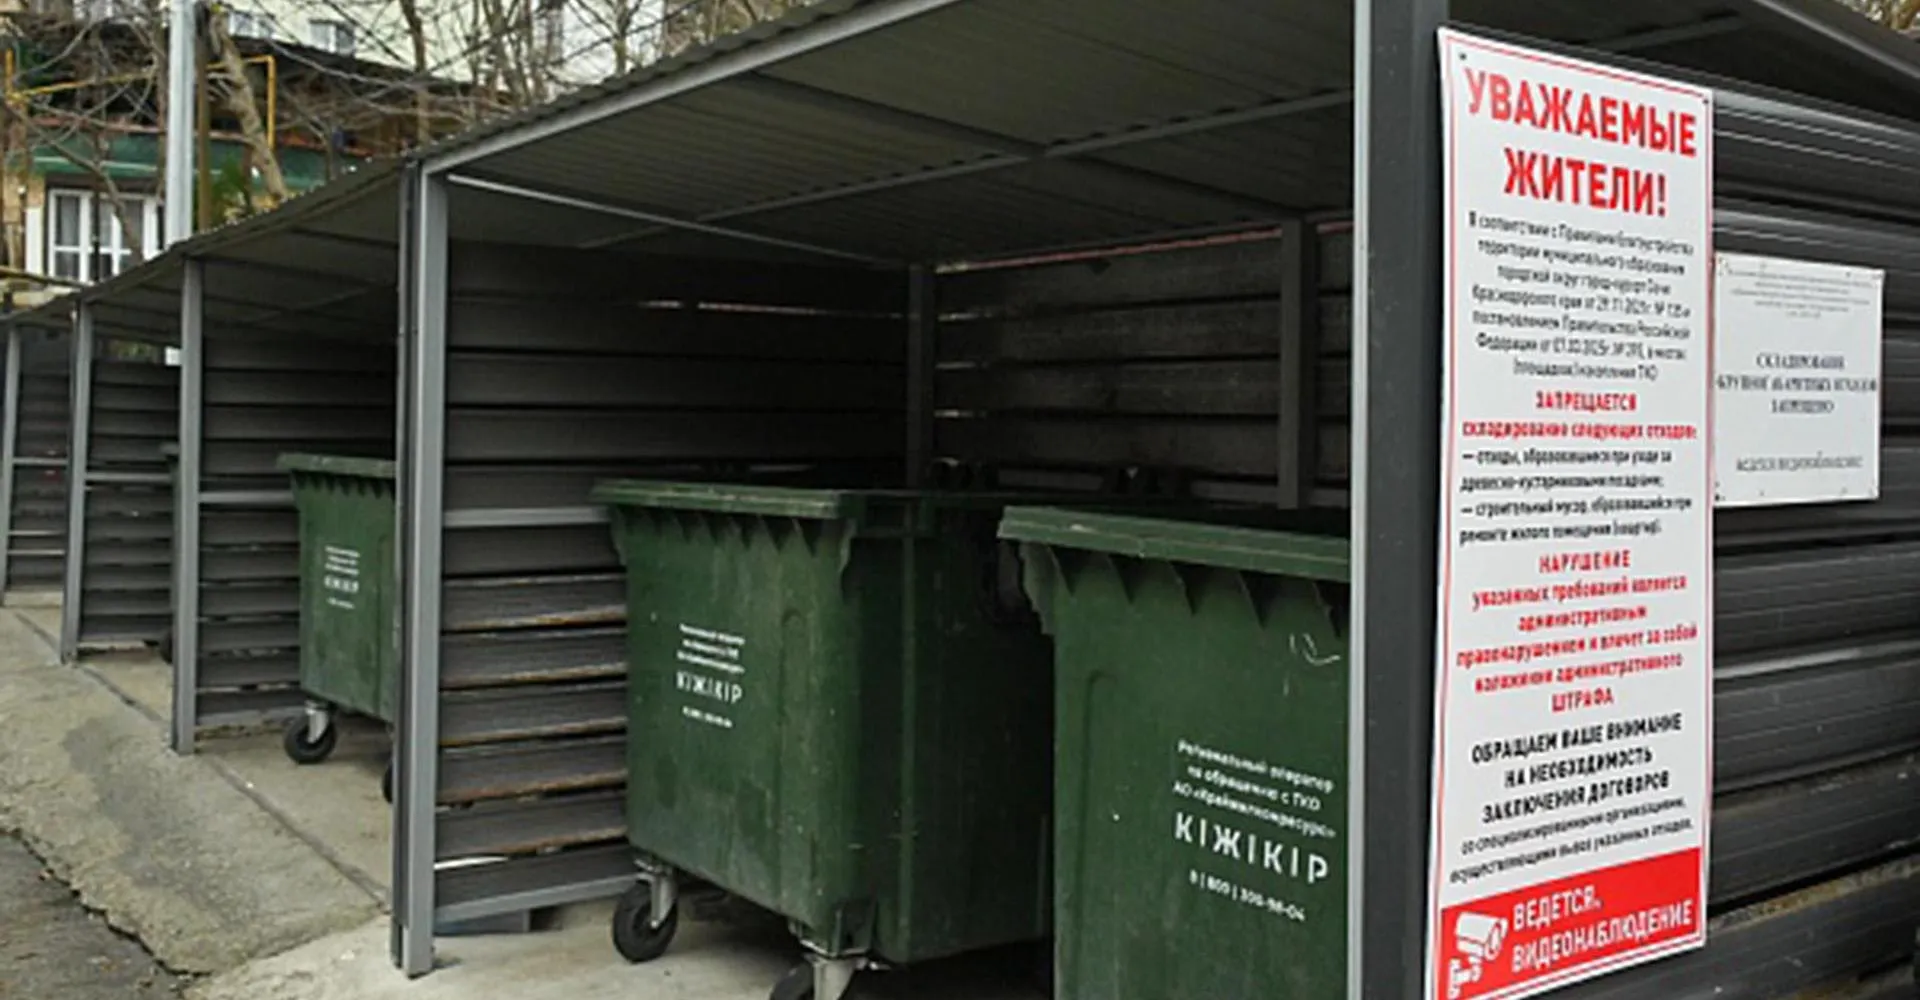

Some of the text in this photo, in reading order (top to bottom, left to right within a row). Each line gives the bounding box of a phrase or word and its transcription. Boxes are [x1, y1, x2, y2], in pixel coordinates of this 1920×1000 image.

[1464, 67, 1697, 157] УВАЖАЕМЫЕ
[1504, 148, 1666, 217] ЖИТЕЛИ!
[1536, 390, 1637, 414] ЗАПРЕЩАЕТСЯ
[1539, 549, 1630, 573] НАРУШЕНИЕ
[1552, 687, 1615, 712] ШТРАФА
[1471, 712, 1682, 764] ОБРАЩАЕМ ВАШЕ ВНИМАНИЕ
[1504, 747, 1653, 788] НА НЕОБХОДИМОСТЬ
[1293, 791, 1322, 811] ТКО
[1481, 770, 1670, 824] ЗАКЛЮЧЕНИЯ ДОГОВОРОВ
[1511, 899, 1693, 973] ВИДЕОНАБЛЮДЕНИЕ
